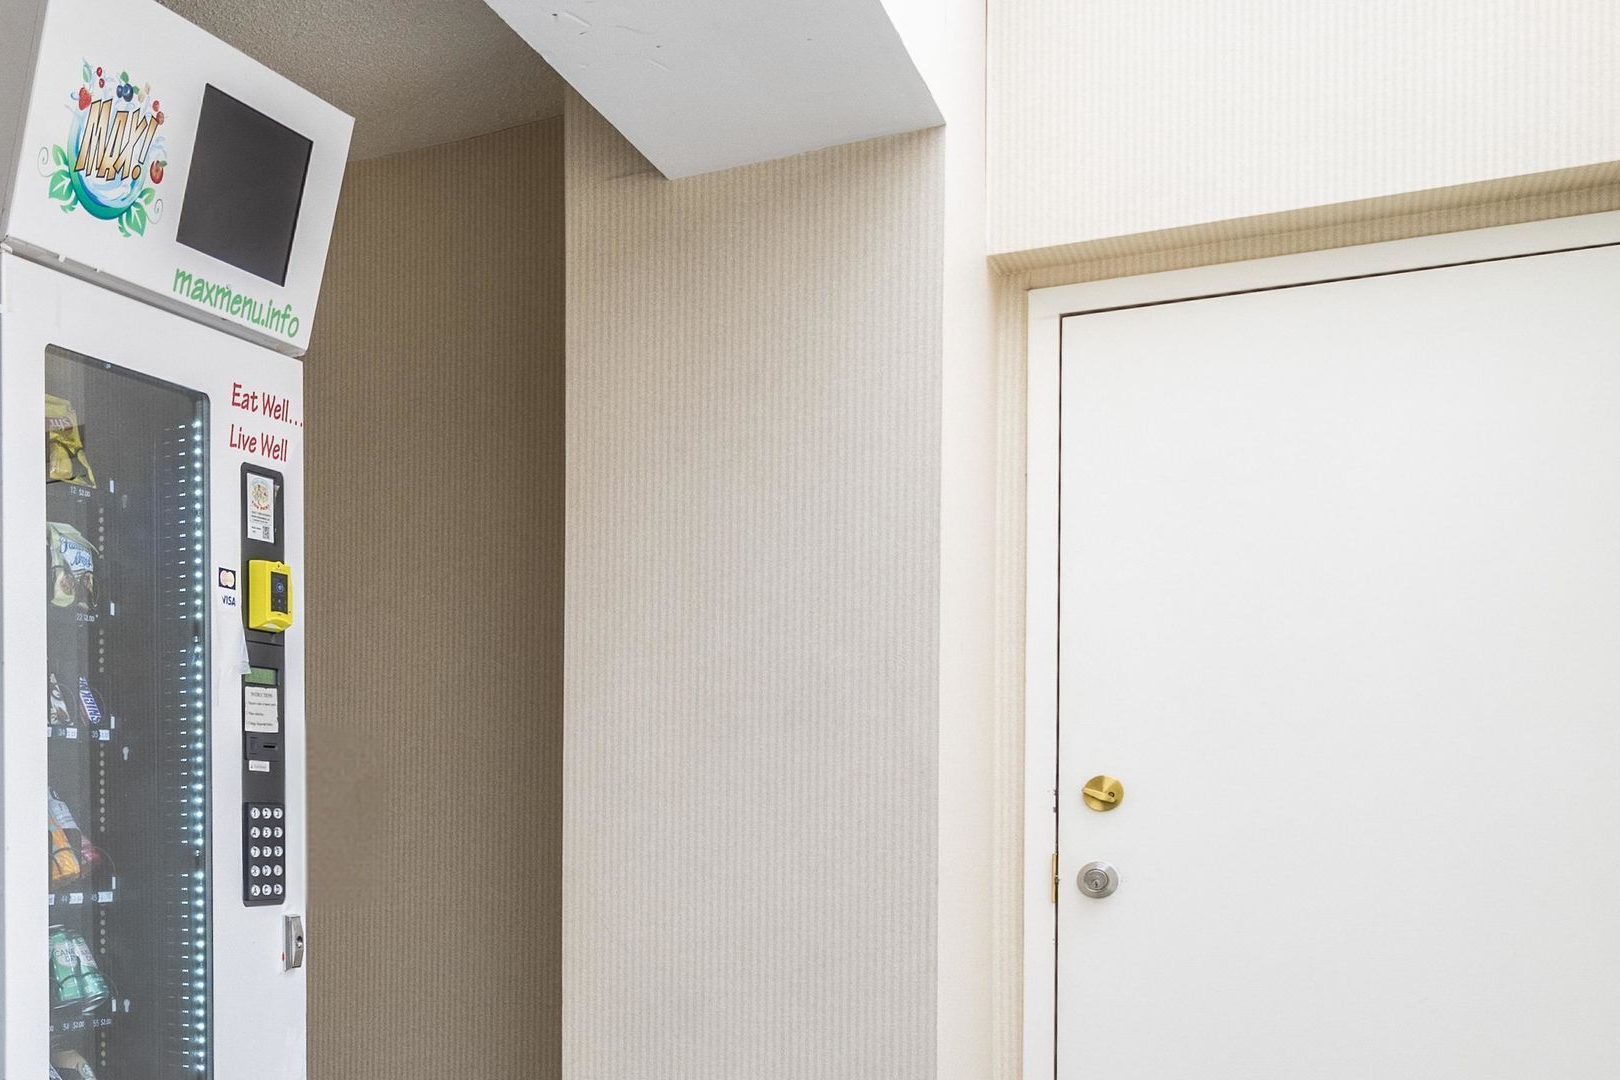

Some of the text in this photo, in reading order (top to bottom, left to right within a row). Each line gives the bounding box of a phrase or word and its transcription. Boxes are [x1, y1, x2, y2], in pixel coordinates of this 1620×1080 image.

[74, 98, 159, 182] MAX!
[173, 268, 300, 338] maxmenu.info
[232, 382, 259, 412] Eat
[229, 424, 288, 462] Live Well
[221, 595, 236, 606] VISA
